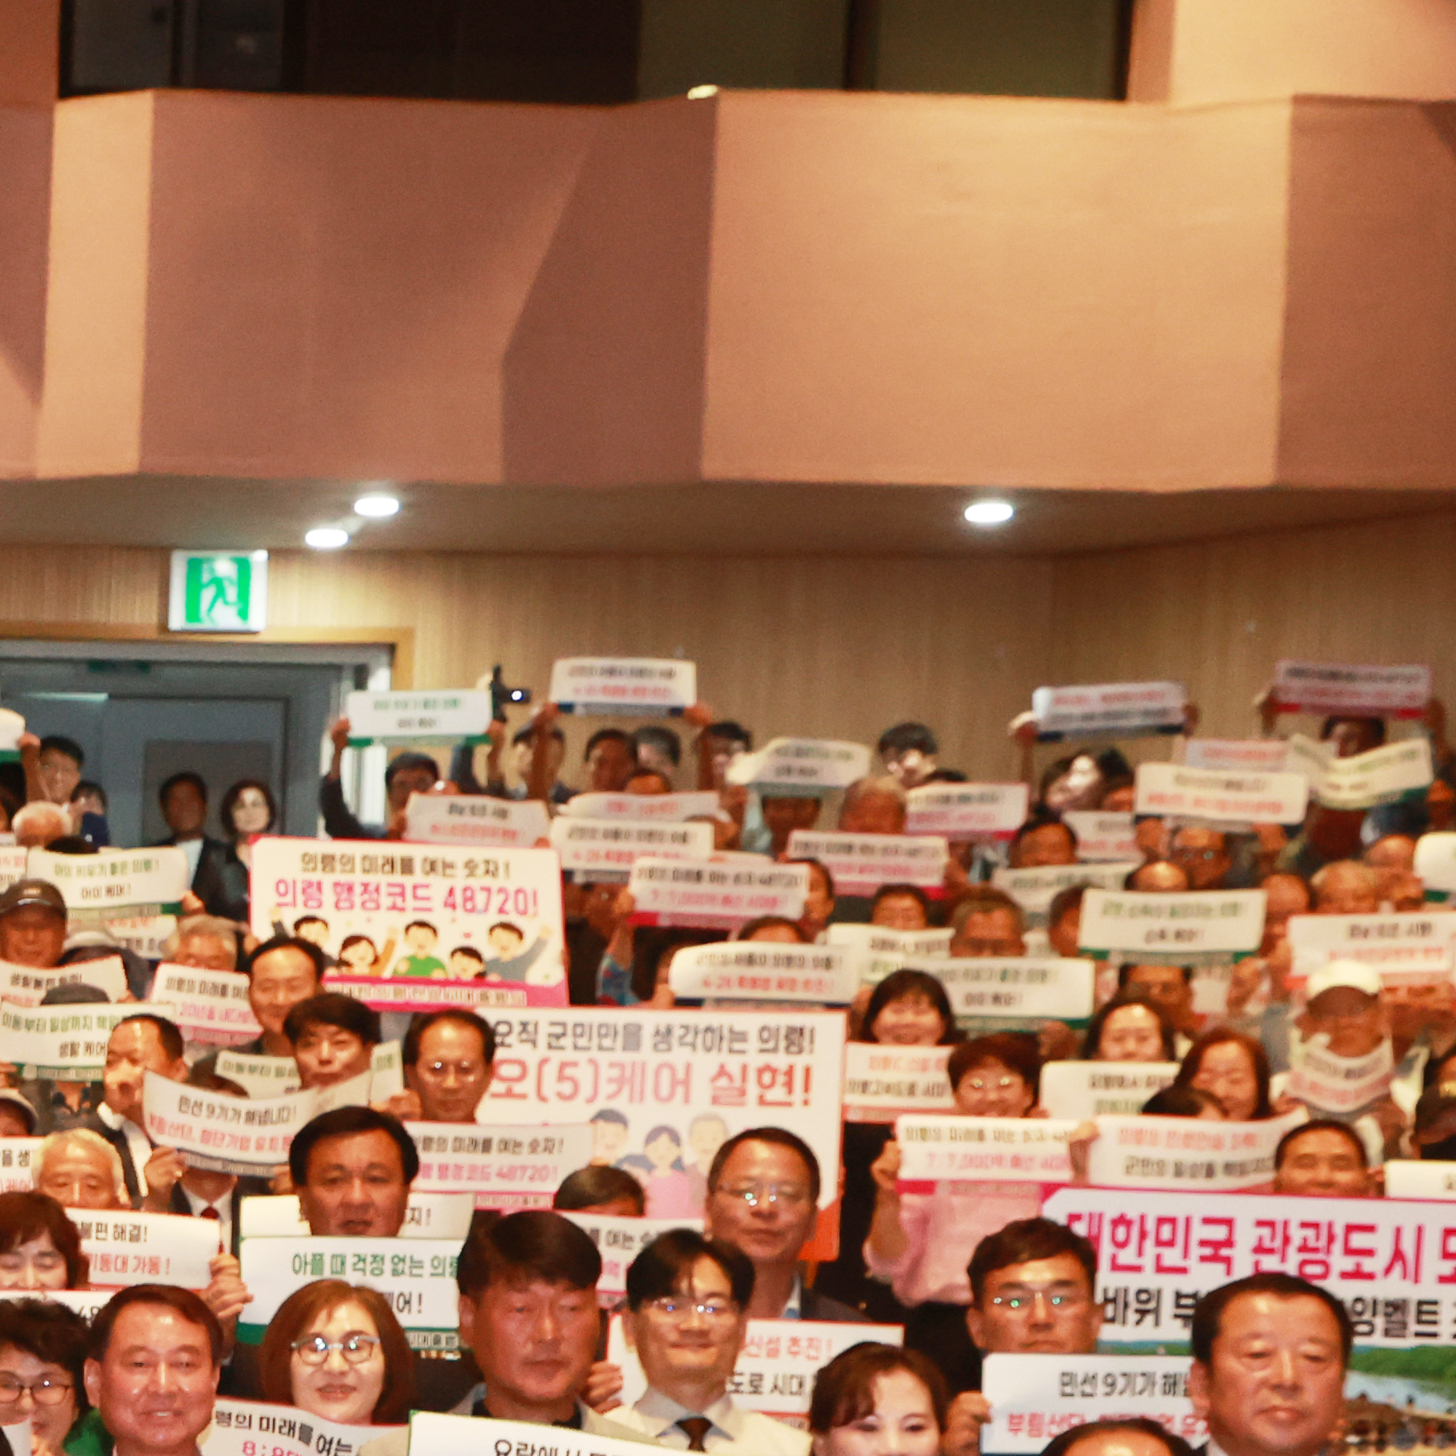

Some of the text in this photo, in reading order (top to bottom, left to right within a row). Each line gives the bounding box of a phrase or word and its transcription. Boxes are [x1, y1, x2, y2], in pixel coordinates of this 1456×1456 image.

[276, 878, 323, 909] 의령
[334, 881, 432, 912] 행정코드
[547, 1022, 643, 1051] 군민만을
[654, 1025, 747, 1054] 생각하는
[352, 1253, 425, 1277] 걱정 없는
[1252, 1218, 1427, 1284] 관광도시
